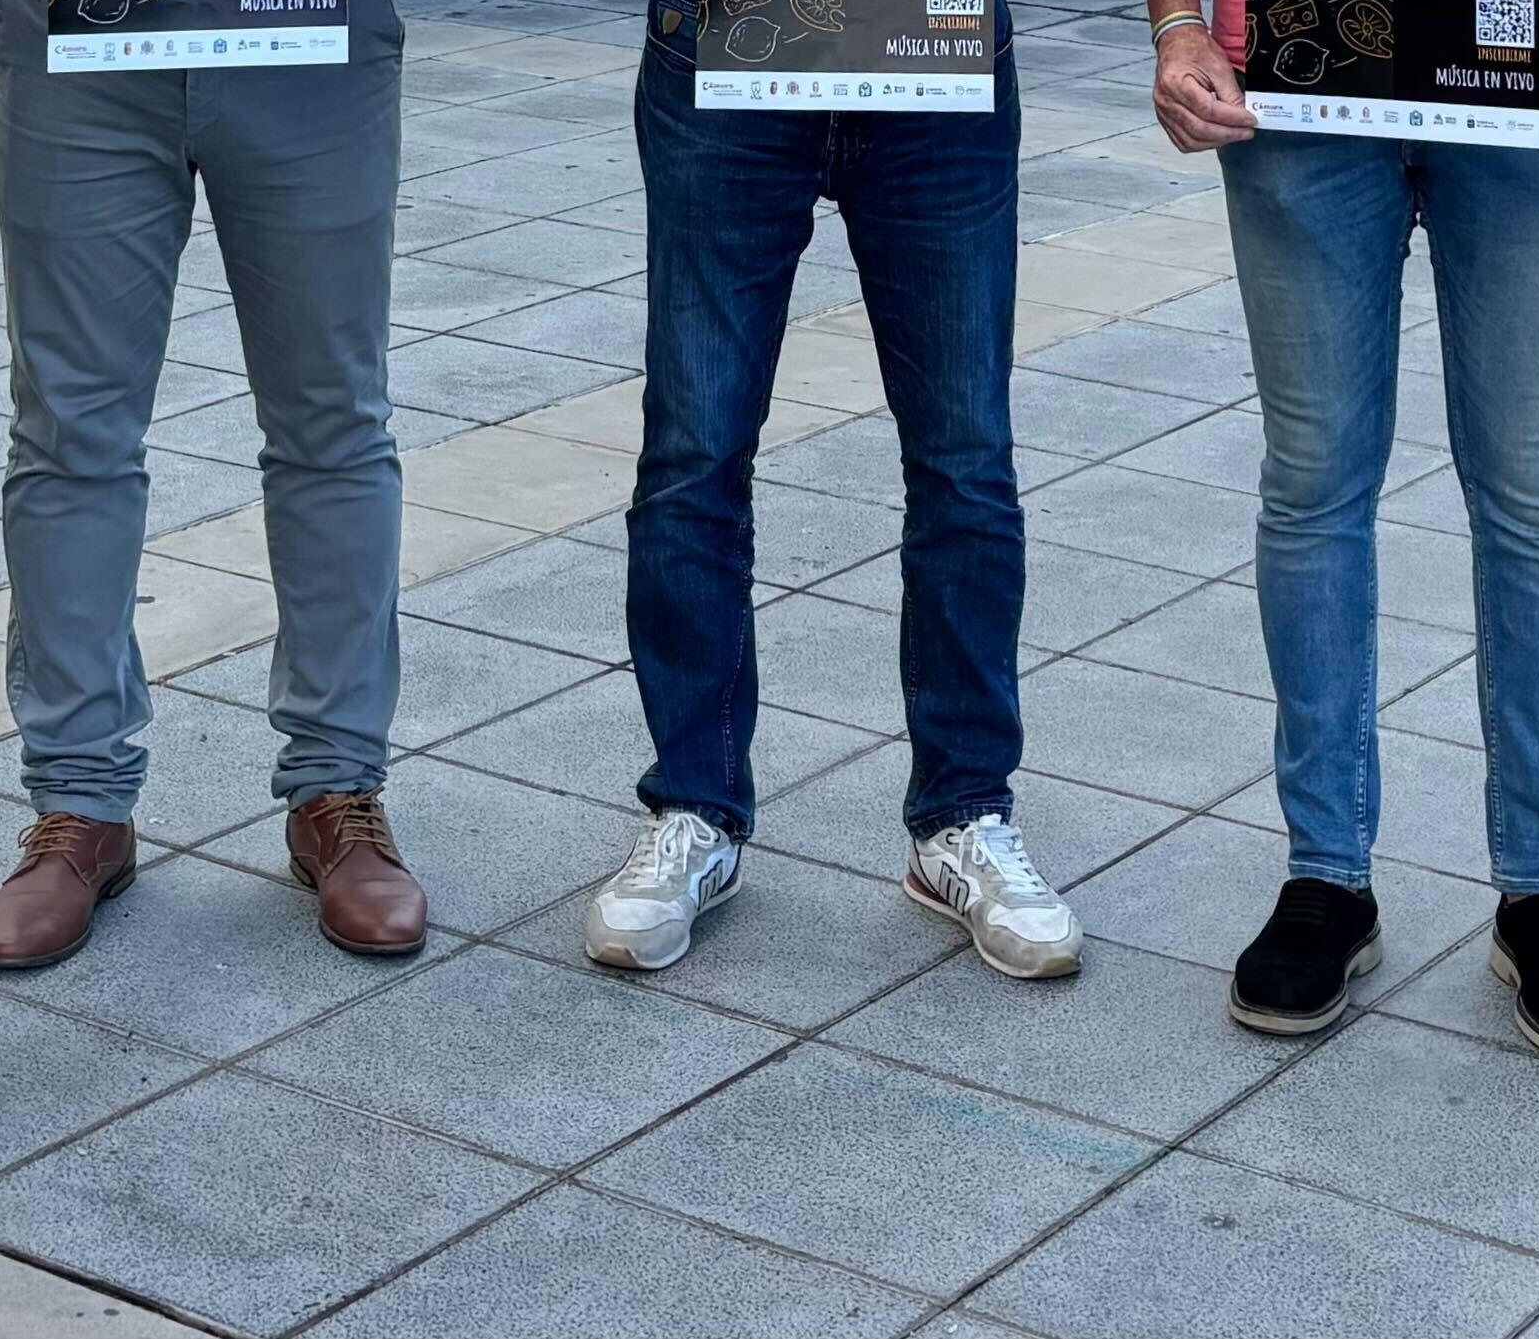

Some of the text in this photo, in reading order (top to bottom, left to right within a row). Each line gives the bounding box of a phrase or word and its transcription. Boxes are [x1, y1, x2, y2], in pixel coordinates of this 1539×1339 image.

[886, 35, 982, 57] MÚSICA EN VIVO
[1436, 64, 1534, 91] MÚSICA EN VIVO
